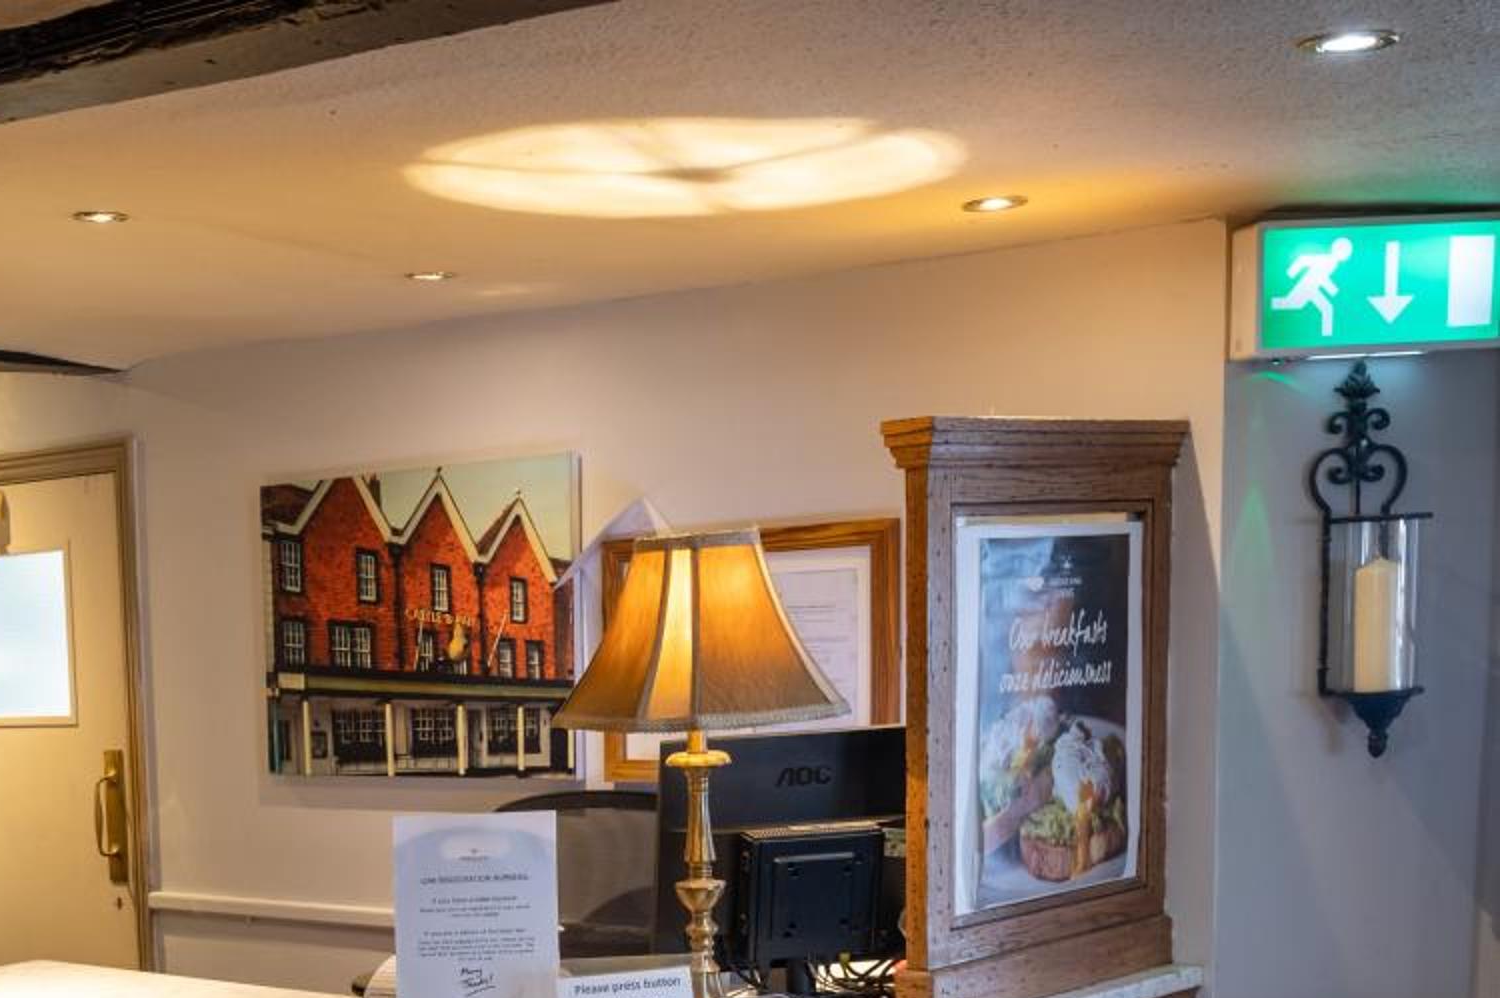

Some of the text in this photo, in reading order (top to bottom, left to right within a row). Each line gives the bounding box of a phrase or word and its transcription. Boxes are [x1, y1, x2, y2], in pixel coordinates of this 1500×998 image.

[775, 766, 832, 788] AOC
[574, 977, 681, 995] Please press button
